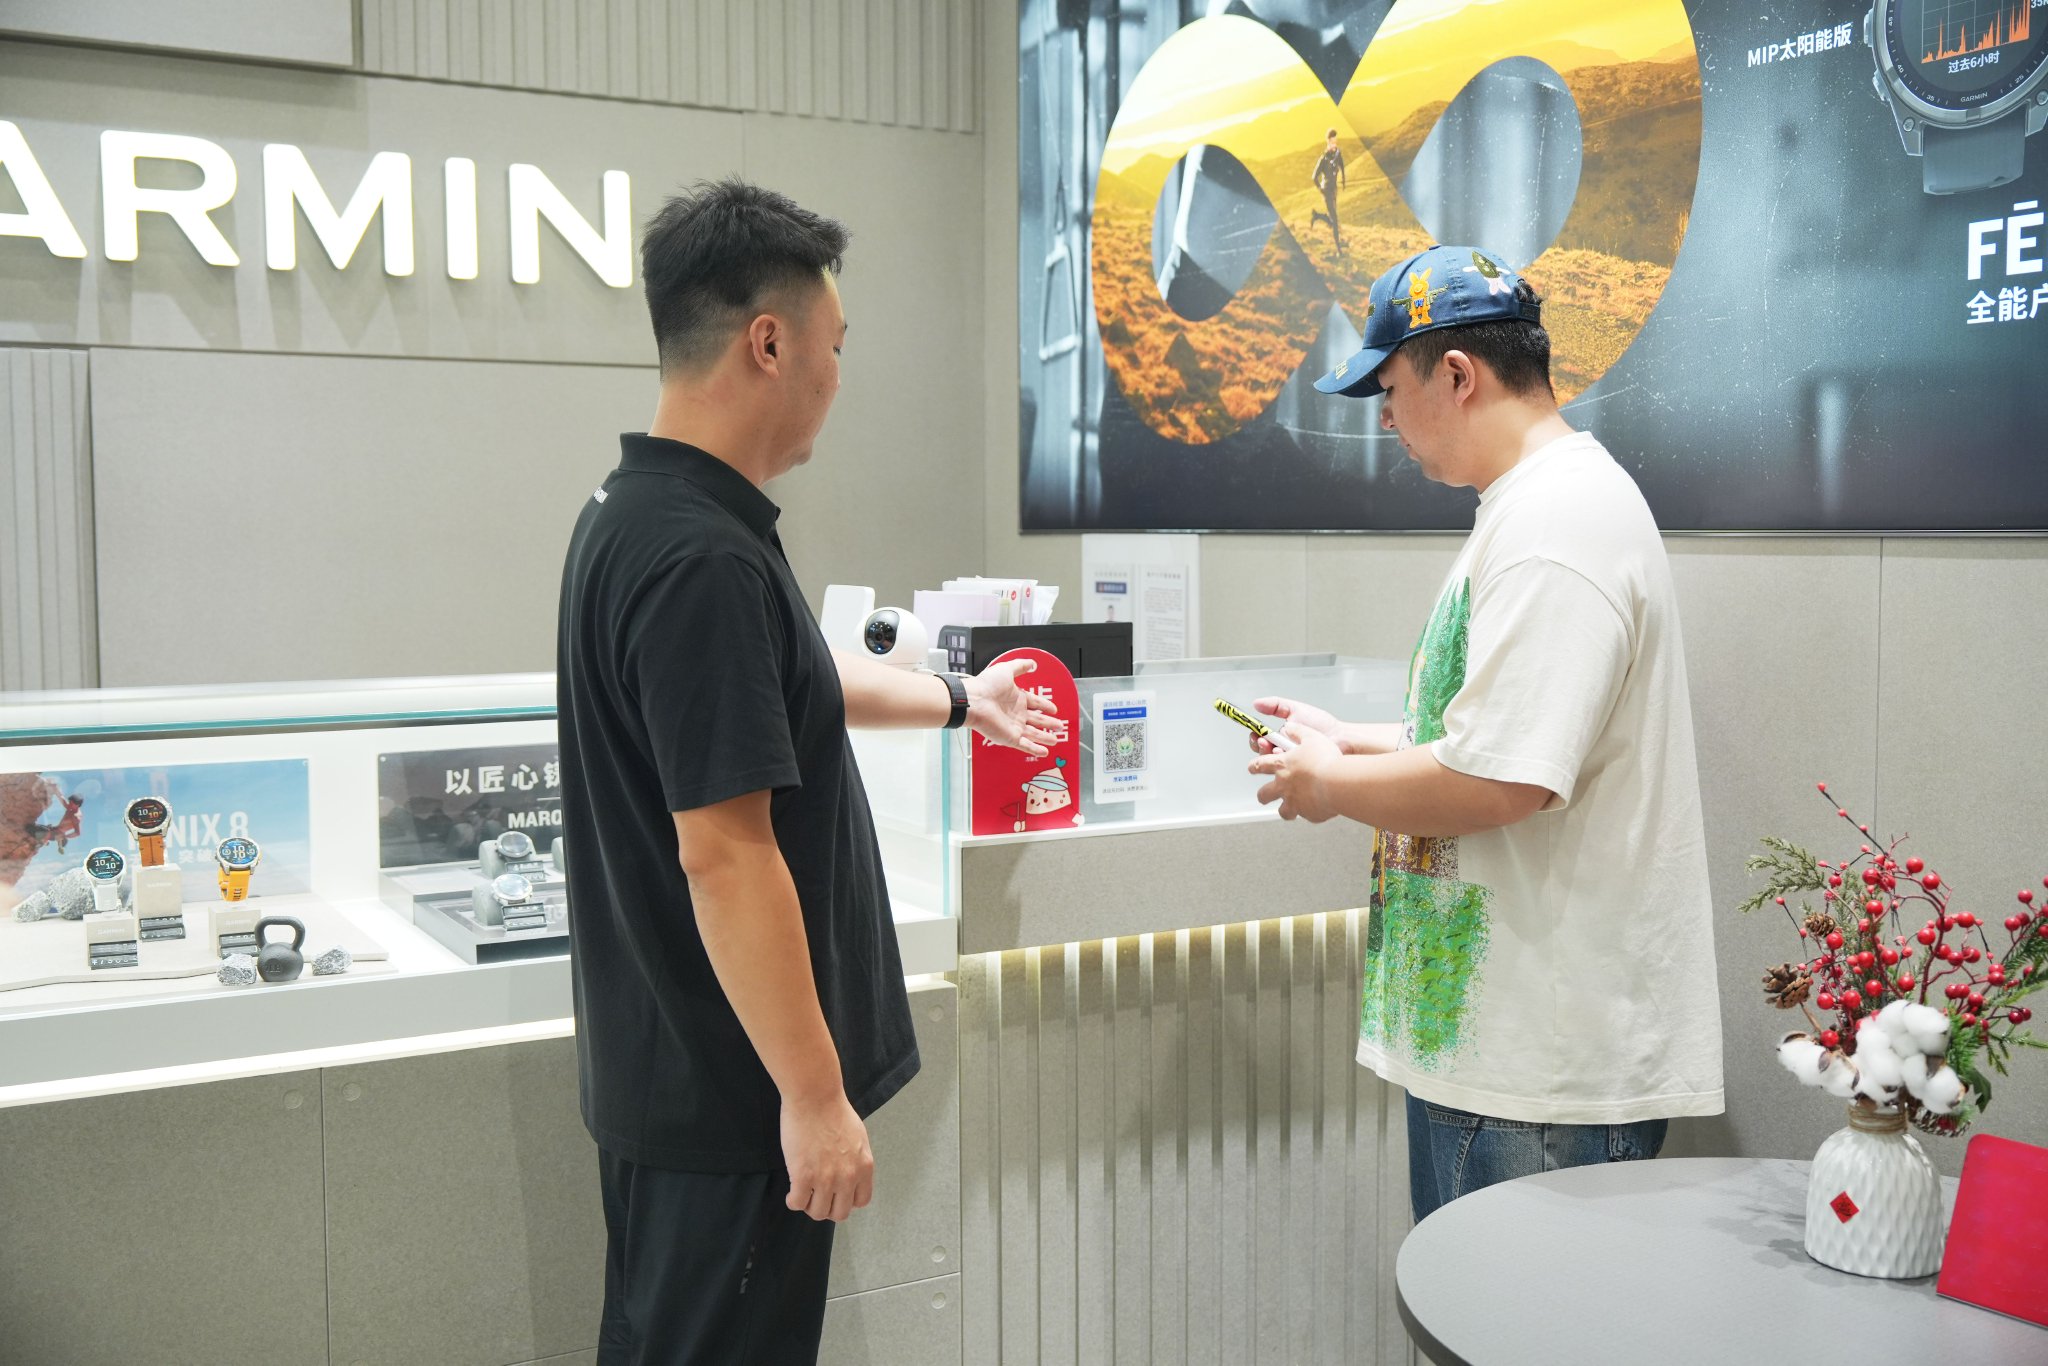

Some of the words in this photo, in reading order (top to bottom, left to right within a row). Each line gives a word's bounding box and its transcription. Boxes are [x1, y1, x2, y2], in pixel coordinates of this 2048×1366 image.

[1747, 22, 1853, 67] MIP太阳能版
[1948, 51, 2000, 73] 过去6小时
[1960, 91, 1988, 103] GARMIN
